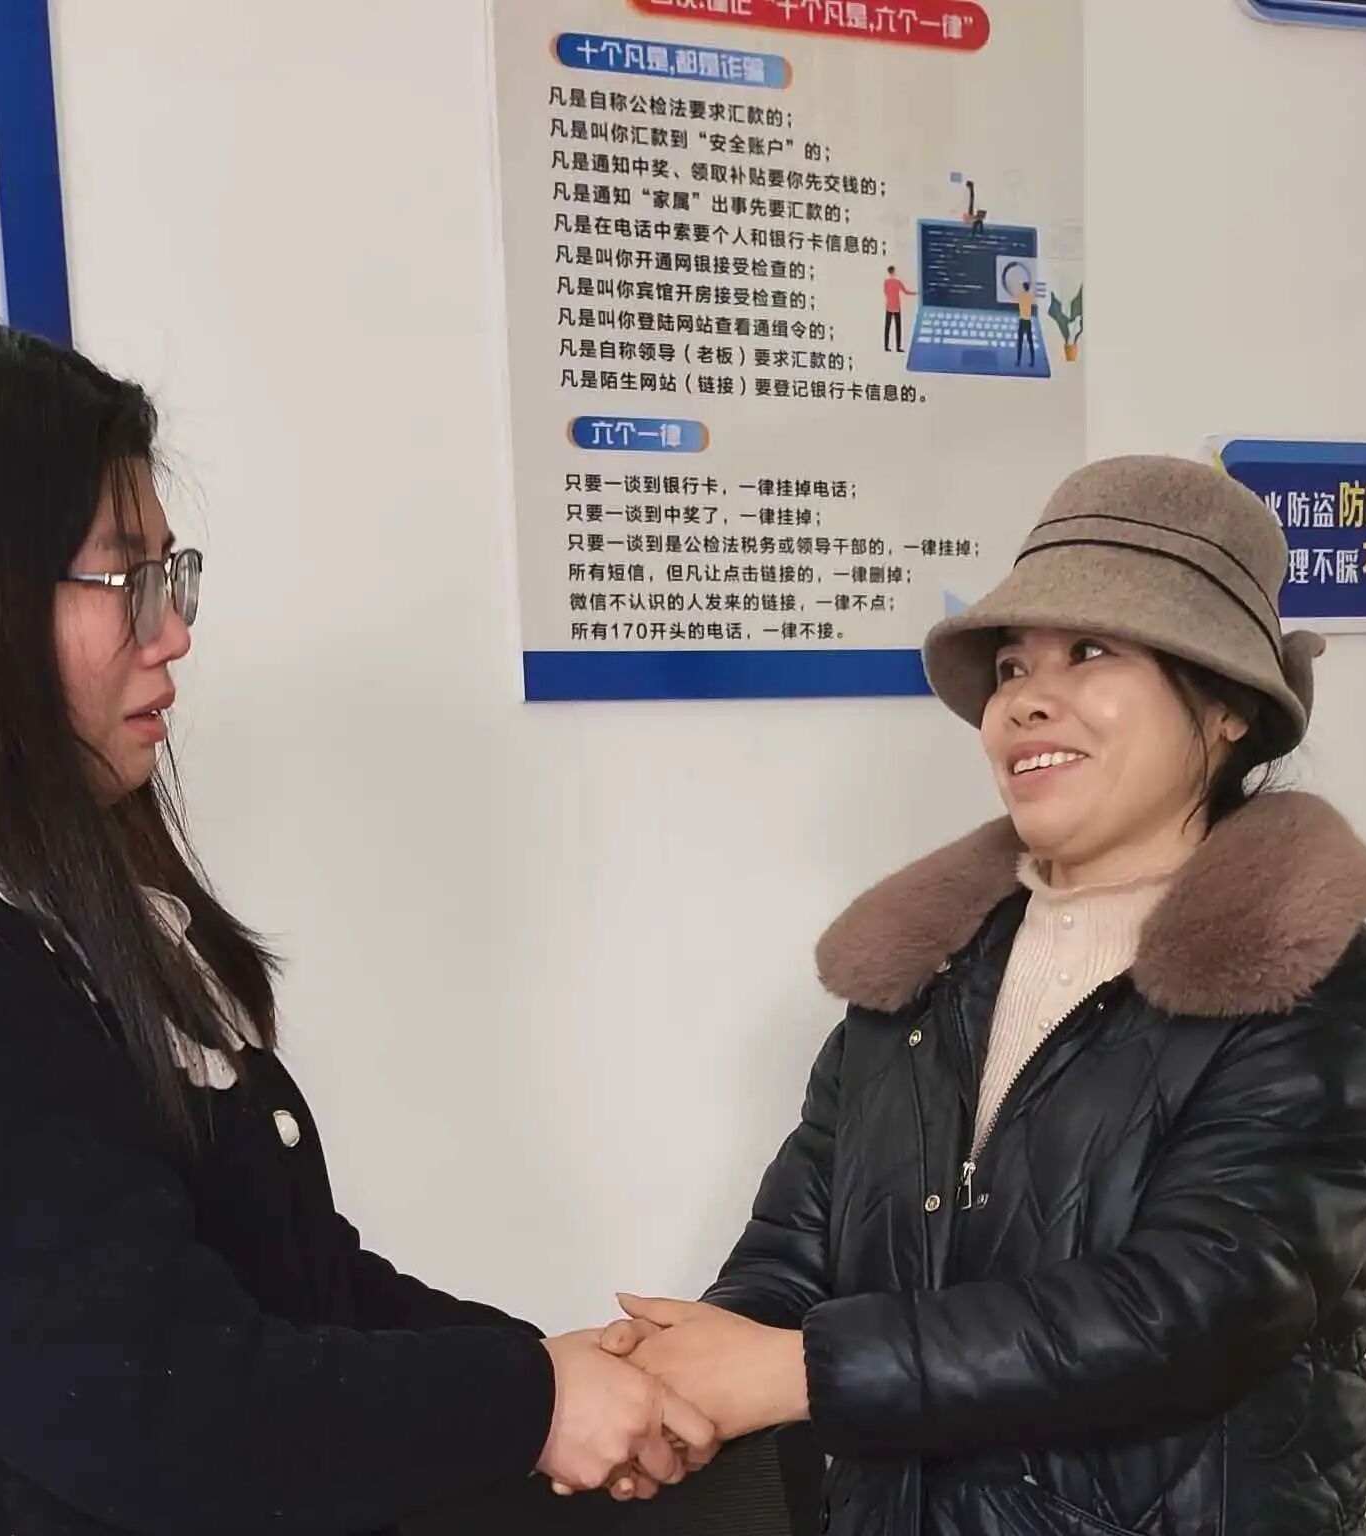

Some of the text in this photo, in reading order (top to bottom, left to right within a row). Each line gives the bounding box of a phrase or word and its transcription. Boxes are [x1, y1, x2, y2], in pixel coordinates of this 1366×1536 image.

[549, 86, 793, 129] 凡是自称公检法要求汇款的；
[551, 150, 887, 197] 凡是通知中奖、领取补贴要你先交钱的；
[554, 213, 889, 257] 凡是在电话中索要个人和银行卡信息的；
[555, 245, 816, 281] 凡是叫你开通网银接受检查的；
[556, 276, 817, 312] 凡是叫你宾馆开房接受检查的；
[557, 307, 834, 342] 凡是叫你登陆网站查看通缉令的；
[591, 421, 682, 448] 六个一律
[565, 473, 858, 499] 只要一谈到银行卡，一律挂掉电话；
[566, 503, 822, 528] 只要一谈到中奖了，一律挂掉；
[567, 533, 981, 559] 只要一谈到是公检法税务或领导干部的，一律挂掉；
[568, 563, 912, 585] 所有短信，但凡让点击链接的，一律删掉；
[570, 593, 895, 613] 微信不认识的人发来的链接，一律不点；
[571, 621, 846, 641] 所有170开头的电话，一律不接。
